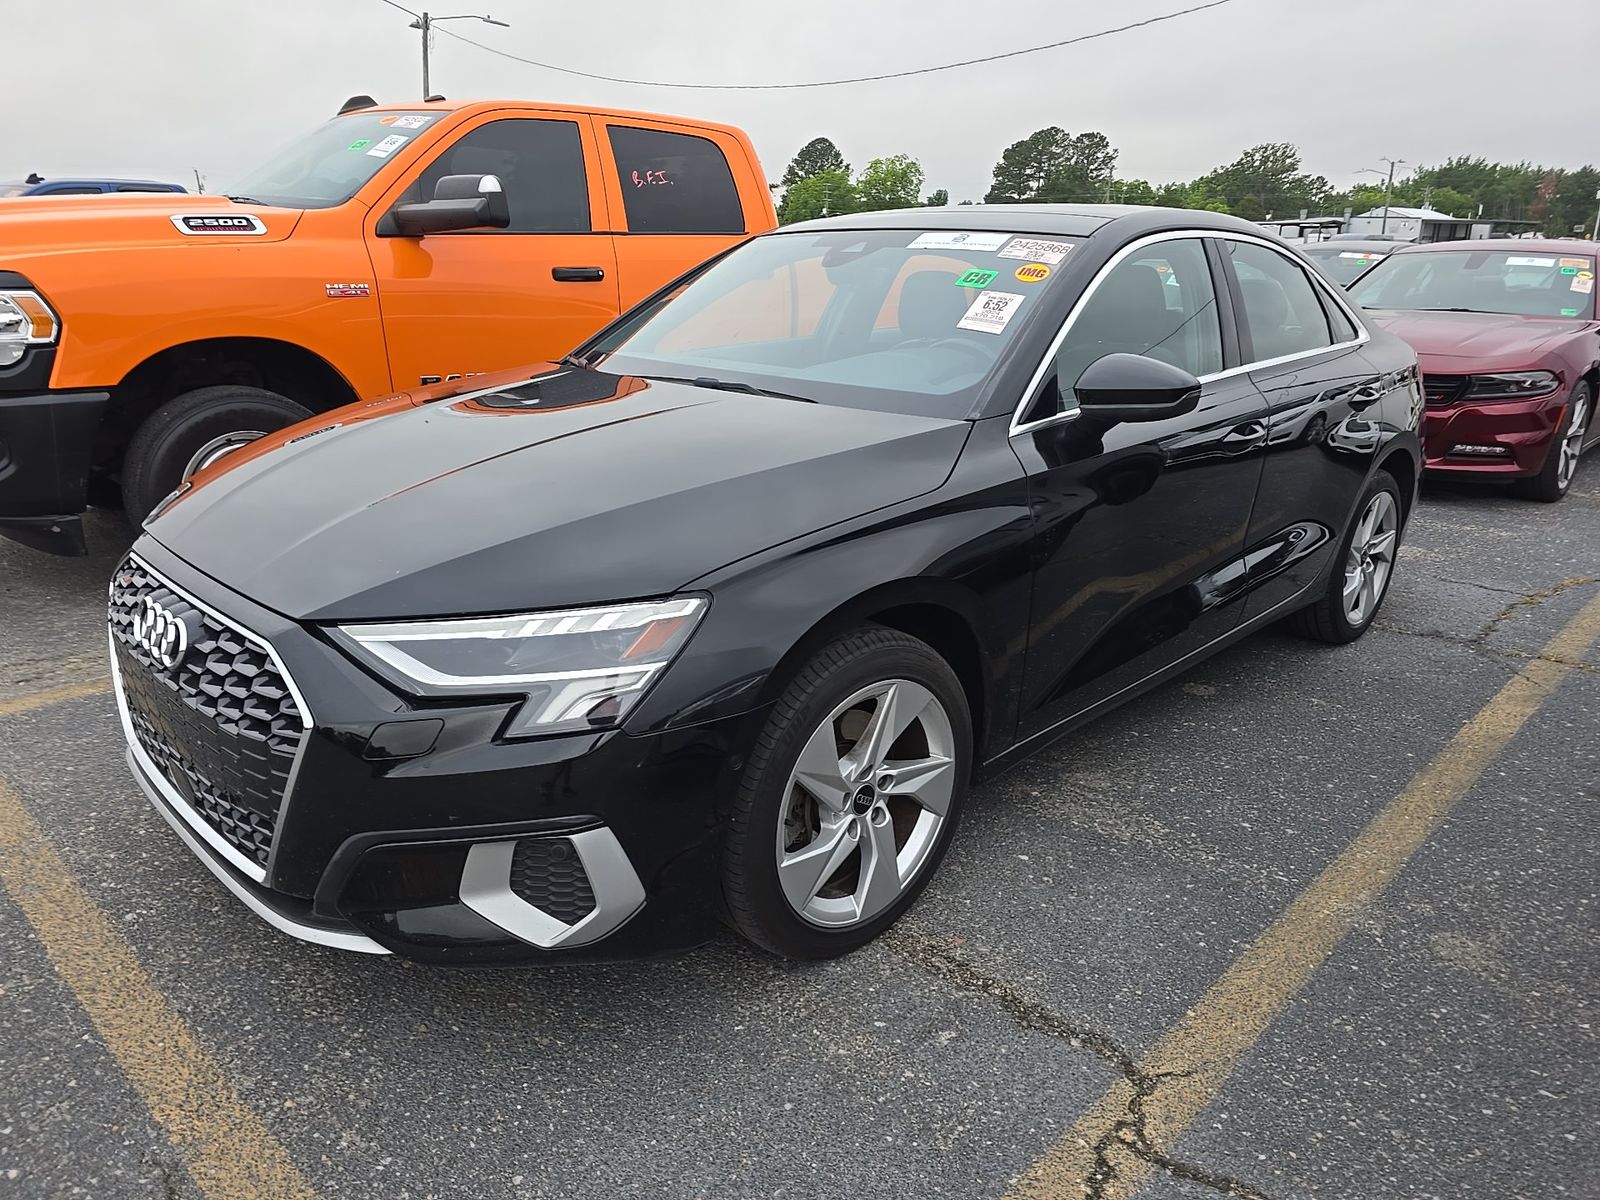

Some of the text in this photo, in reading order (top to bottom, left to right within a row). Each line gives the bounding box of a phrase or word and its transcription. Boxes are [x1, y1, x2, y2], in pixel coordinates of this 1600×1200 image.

[188, 218, 248, 226] 2500
[1008, 240, 1069, 255] 2425868
[963, 271, 993, 285] CR
[1017, 267, 1047, 278] IMG
[982, 299, 1008, 312] 6:52
